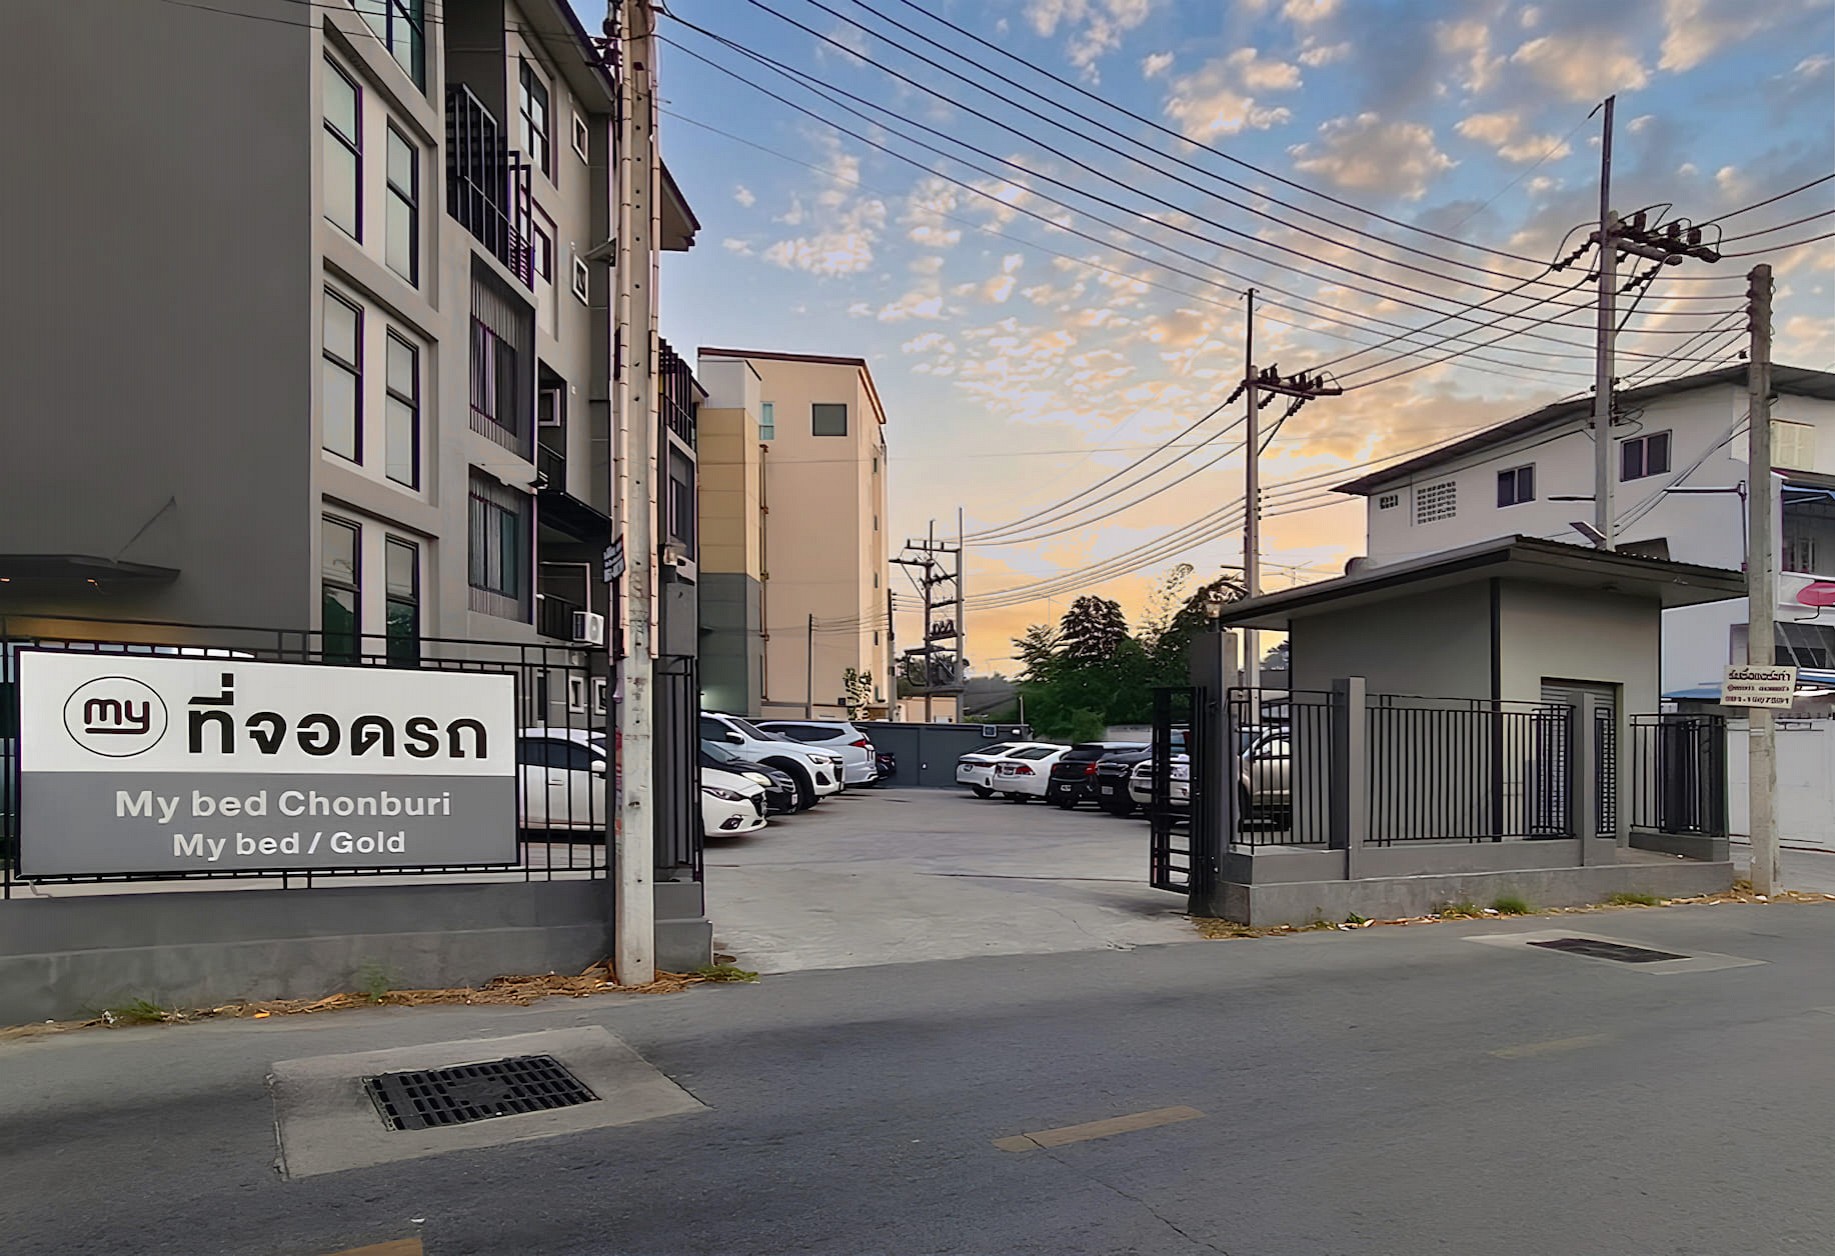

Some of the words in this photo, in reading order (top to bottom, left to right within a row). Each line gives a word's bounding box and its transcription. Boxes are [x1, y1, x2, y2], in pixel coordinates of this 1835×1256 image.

[188, 672, 488, 759] ที่จอดรถ
[116, 790, 180, 824] My
[192, 790, 267, 817] bed
[278, 790, 451, 817] Chonburi
[173, 833, 226, 862] My
[236, 831, 300, 855] bed
[330, 830, 406, 854] Gold
